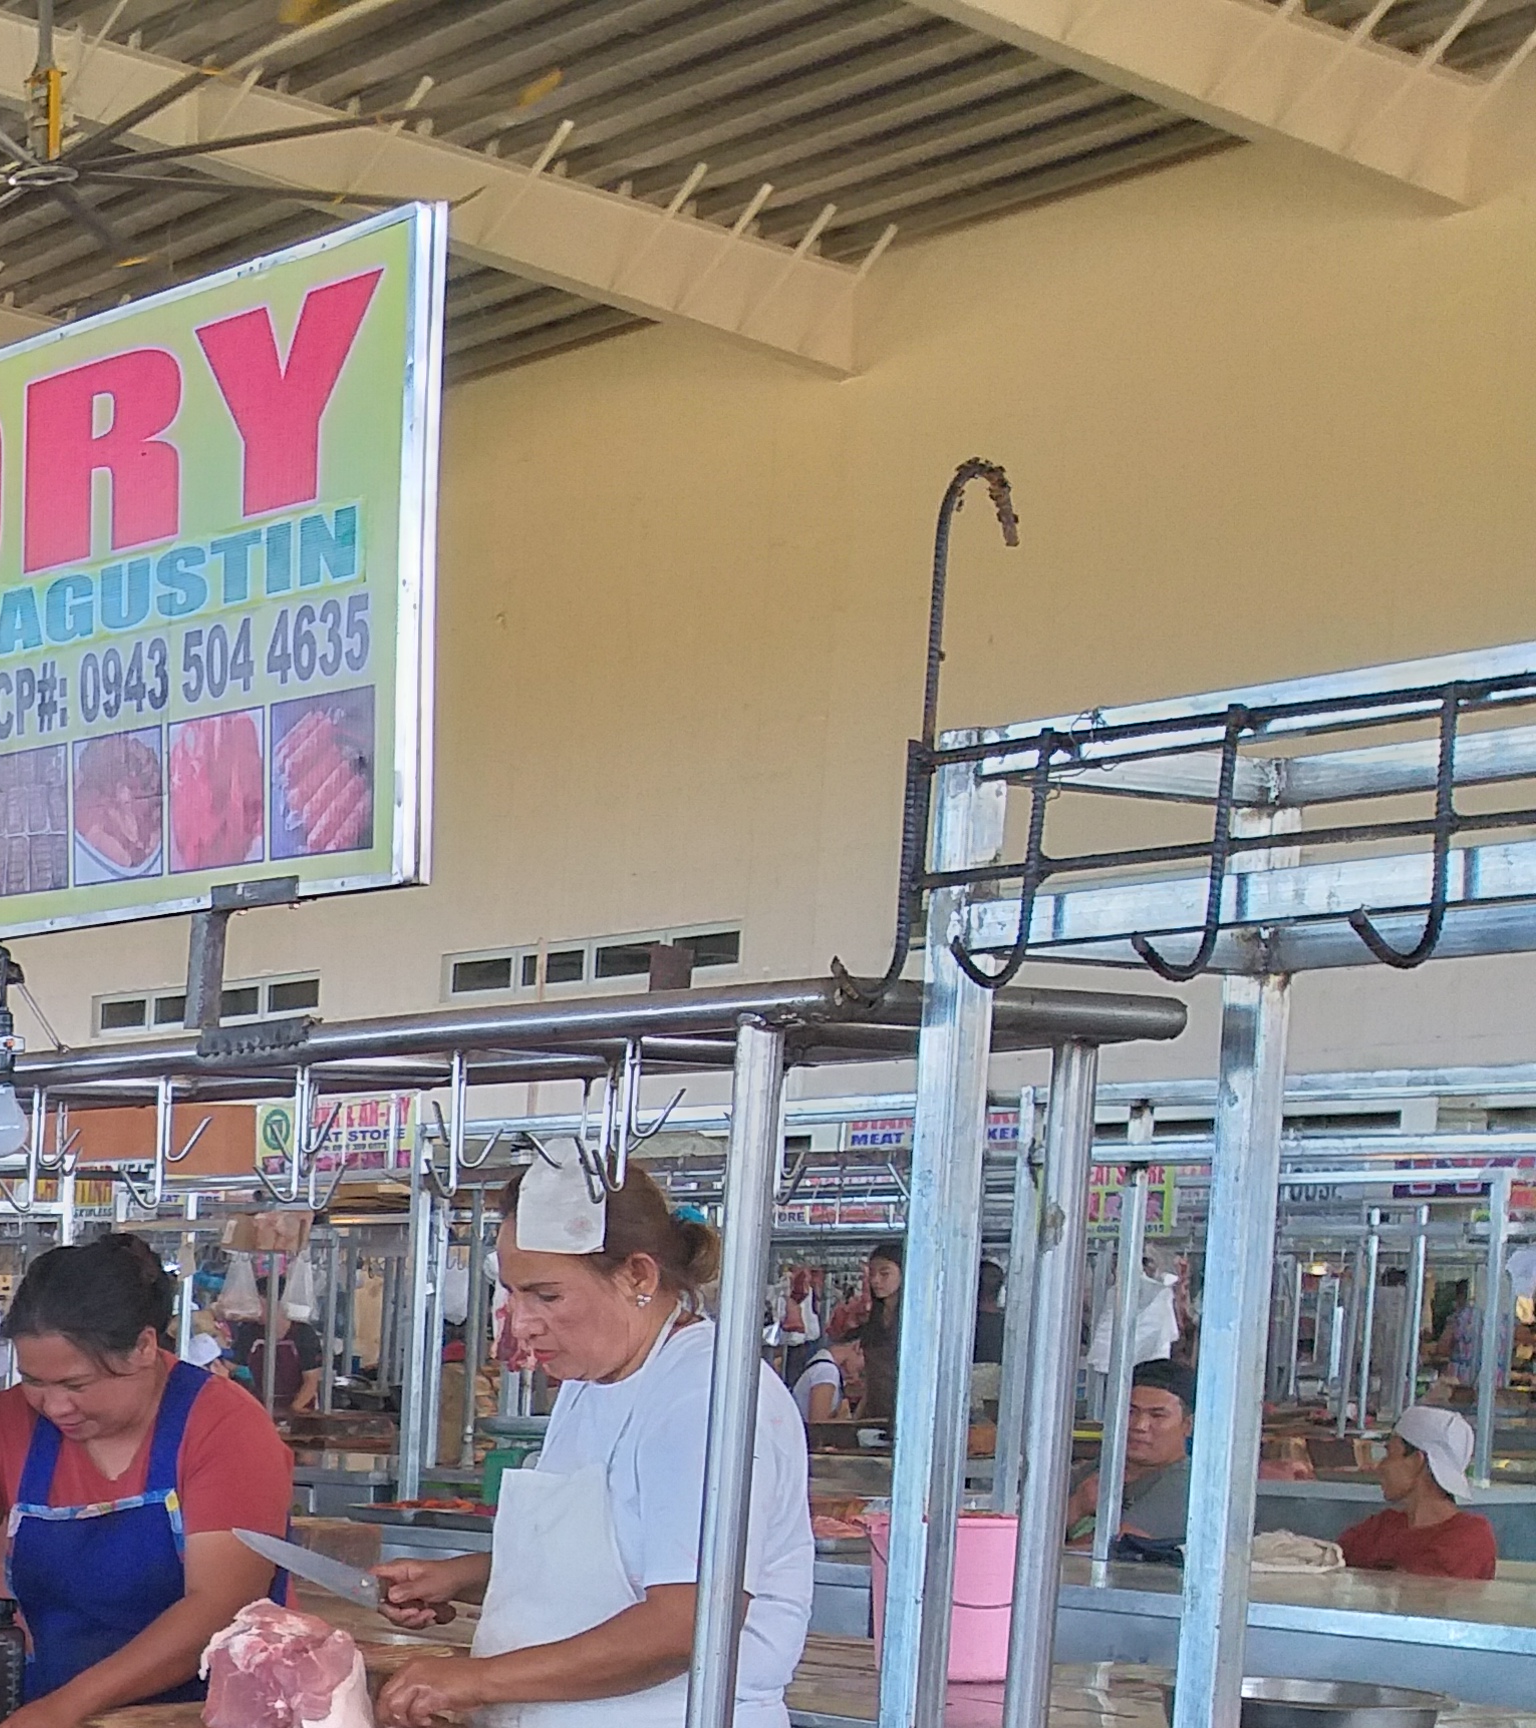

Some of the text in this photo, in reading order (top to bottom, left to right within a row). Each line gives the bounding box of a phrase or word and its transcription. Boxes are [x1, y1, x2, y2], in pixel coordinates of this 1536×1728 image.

[80, 648, 171, 724] 0943
[181, 625, 256, 704] 504
[265, 592, 372, 680] 4635
[850, 1131, 905, 1147] MEAT
[777, 1211, 806, 1223] ORE
